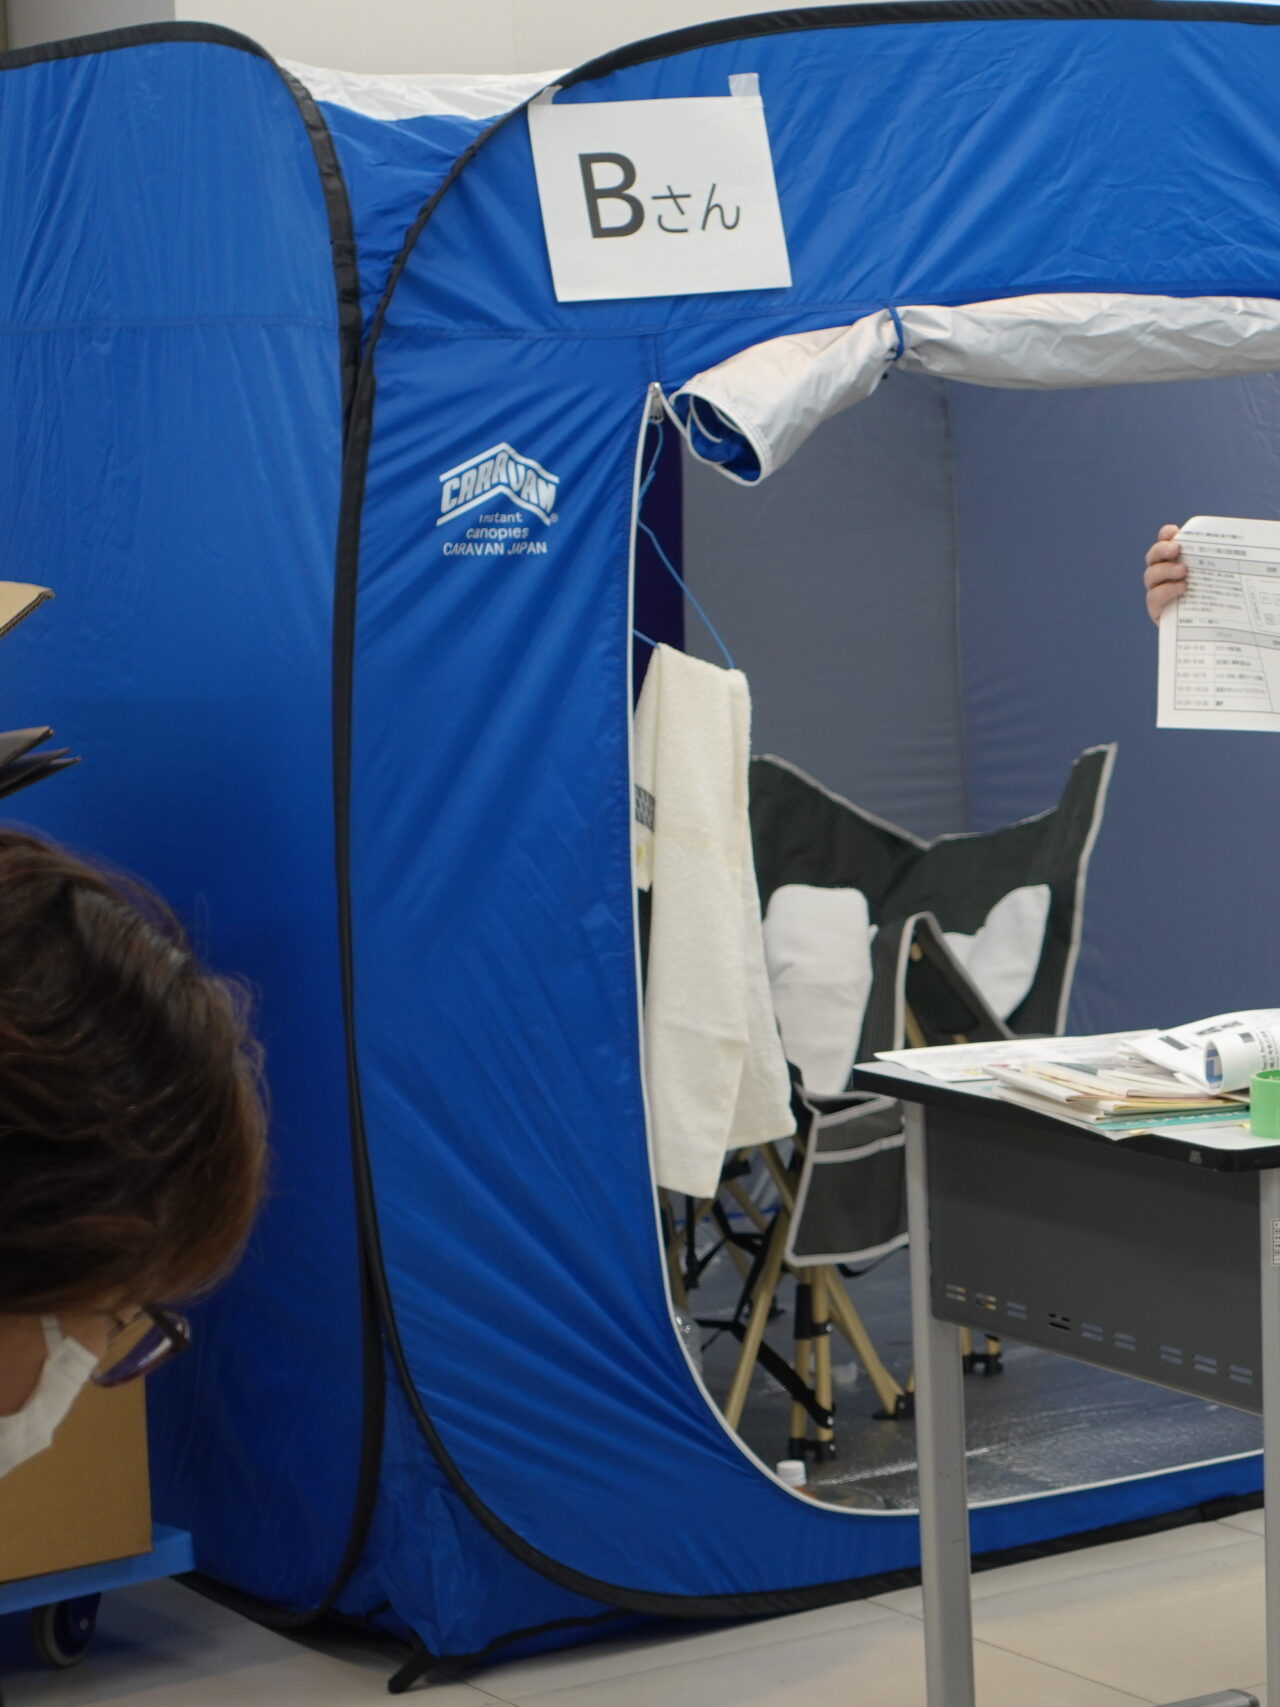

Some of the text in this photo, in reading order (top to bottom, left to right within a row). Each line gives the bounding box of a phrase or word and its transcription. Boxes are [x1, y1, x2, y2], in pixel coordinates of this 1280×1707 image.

[578, 152, 740, 239] Bさん
[440, 451, 557, 514] CARAVAN
[443, 541, 547, 556] CARAVAN JAPAN
[466, 527, 529, 541] canopies
